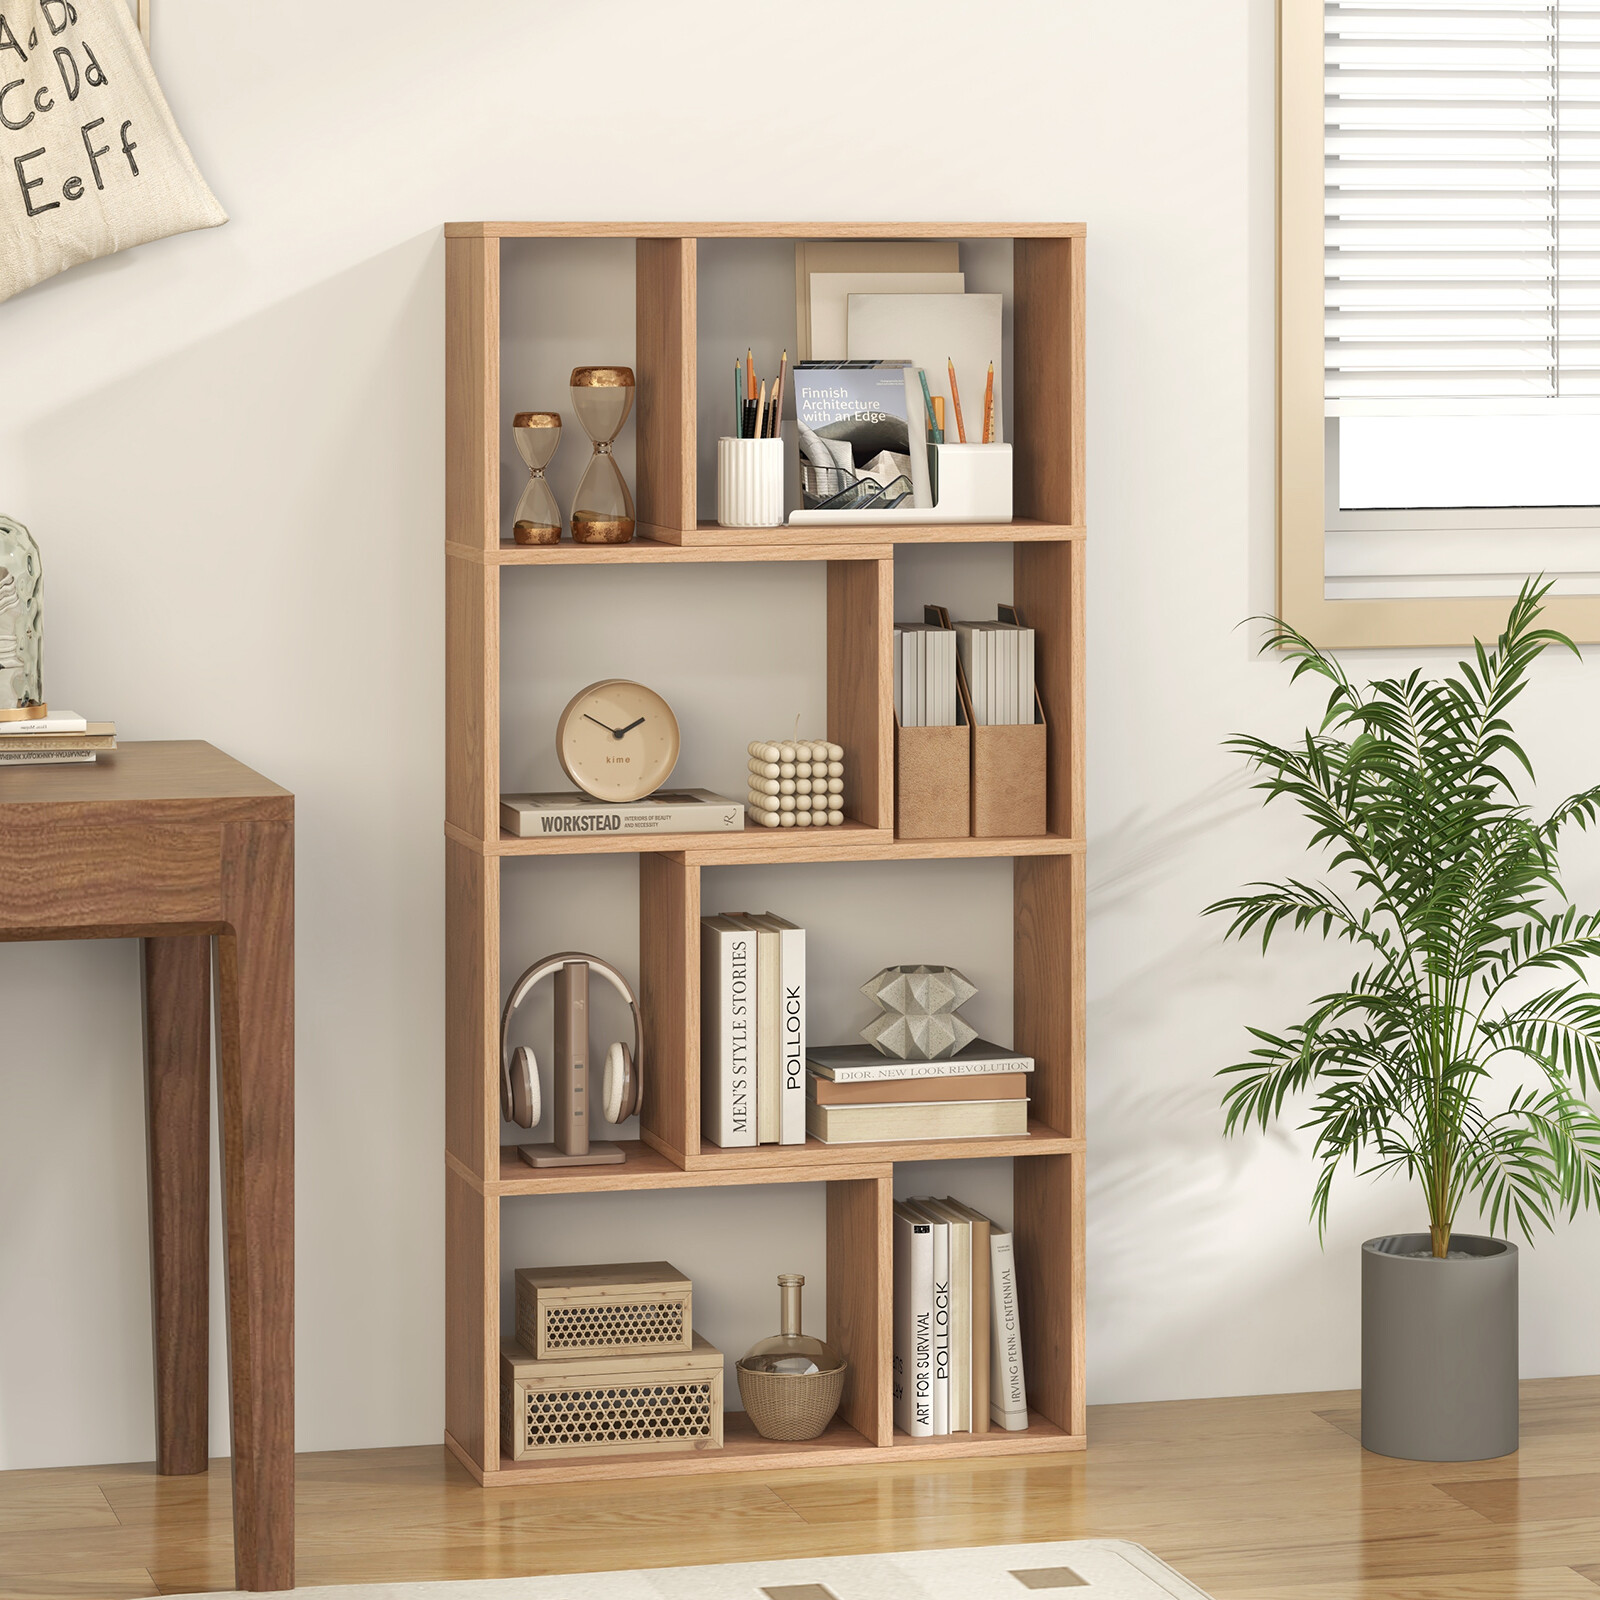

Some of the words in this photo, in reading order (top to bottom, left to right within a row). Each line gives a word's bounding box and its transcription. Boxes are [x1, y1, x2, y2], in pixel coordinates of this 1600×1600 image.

[802, 388, 848, 398] Finnish
[802, 400, 880, 410] Architecture
[803, 411, 831, 421] with
[835, 413, 851, 421] an
[854, 411, 886, 423] Edge
[606, 756, 631, 764] kime
[541, 814, 621, 833] WORKSTEAD
[732, 941, 747, 1016] STORIES
[732, 1019, 747, 1075] STYLE
[786, 985, 801, 1090] POLLOCK
[878, 1068, 907, 1079] NEW
[910, 1066, 945, 1077] LOOK
[949, 1062, 1030, 1075] REVOLUTION
[1001, 1268, 1015, 1331] CENTENNIAL
[916, 1312, 930, 1368] SURVIVAL
[935, 1281, 949, 1380] POLLOCK
[1006, 1333, 1018, 1362] PENN:
[916, 1372, 930, 1398] FOR
[1009, 1365, 1021, 1403] IRVING
[916, 1402, 930, 1425] ART
